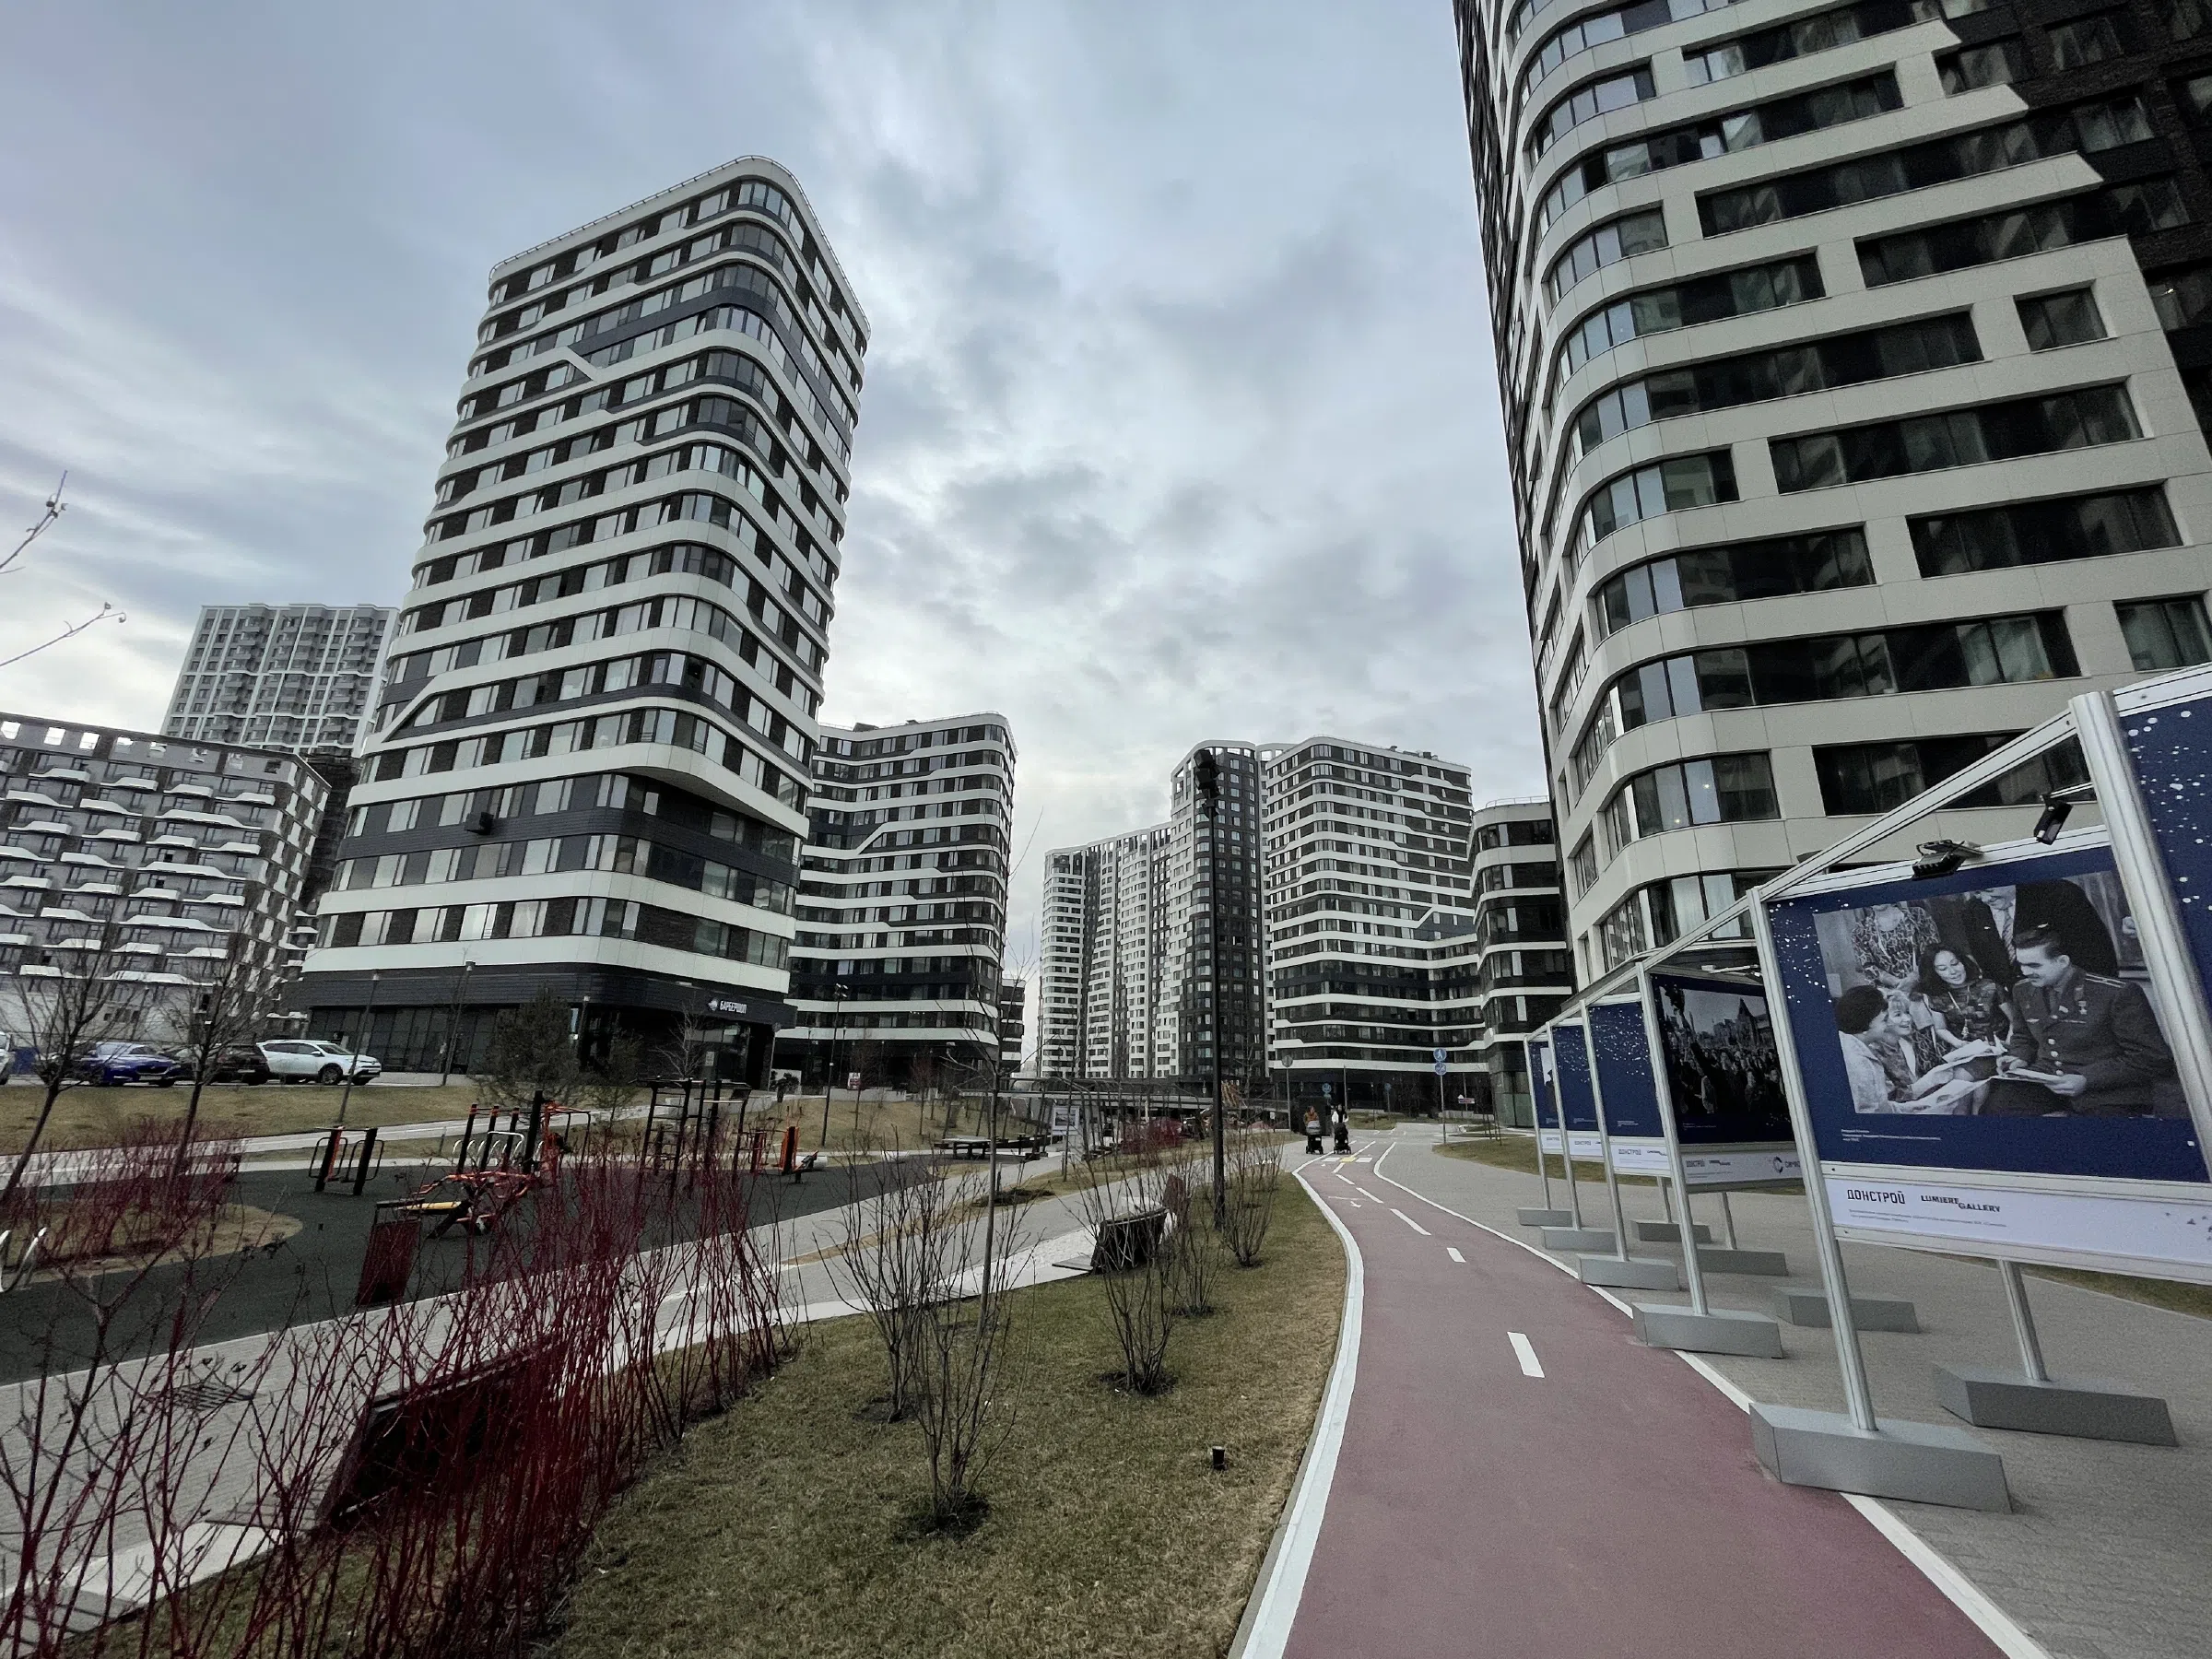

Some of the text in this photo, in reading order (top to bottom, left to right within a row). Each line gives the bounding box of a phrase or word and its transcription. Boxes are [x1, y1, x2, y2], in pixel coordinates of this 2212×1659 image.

[1847, 1189, 1906, 1205] ДОНСТРОЙ
[1921, 1194, 2001, 1212] LUMIERE GALLERY
